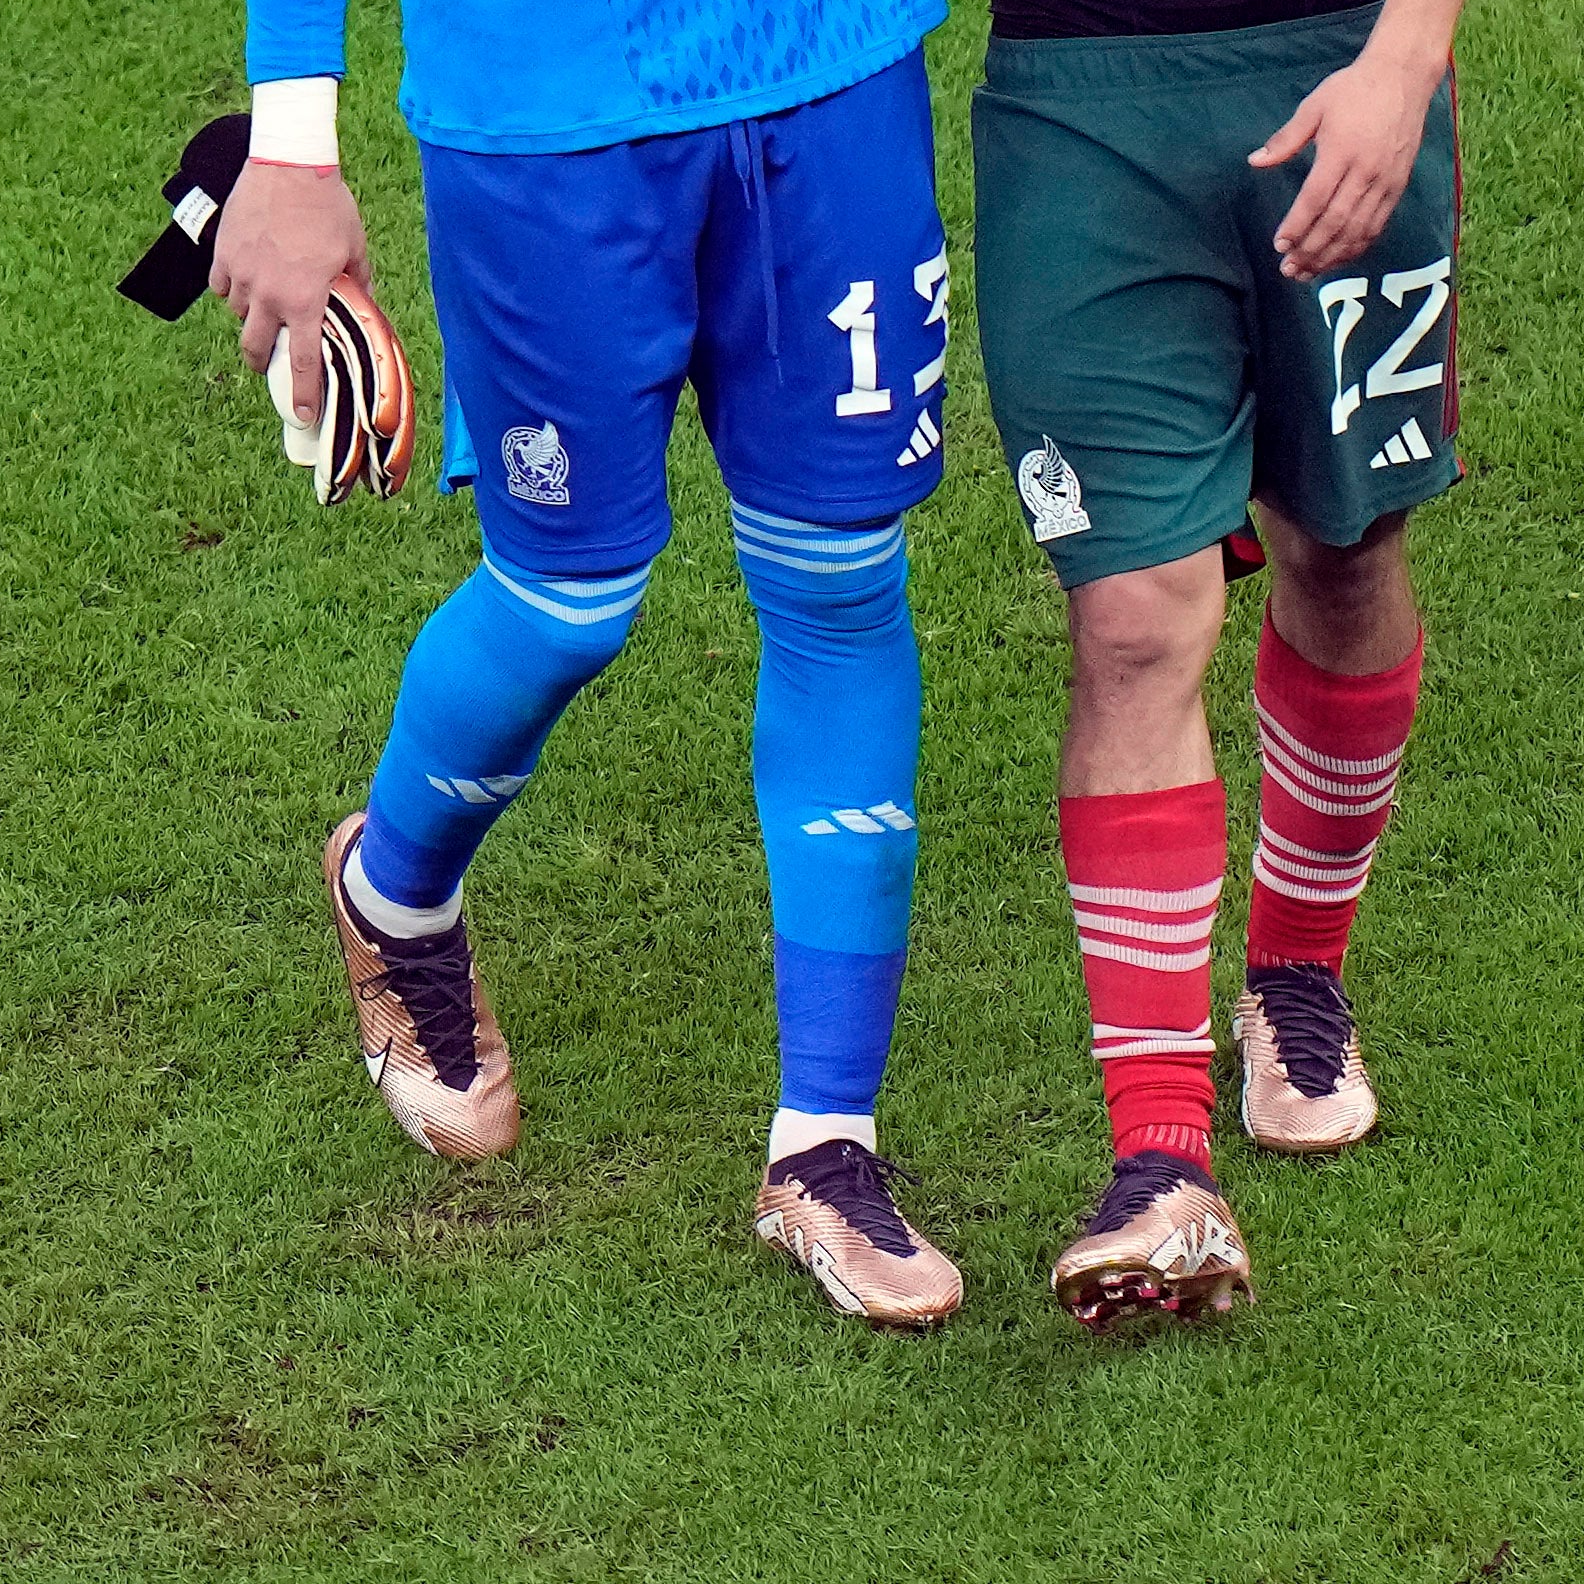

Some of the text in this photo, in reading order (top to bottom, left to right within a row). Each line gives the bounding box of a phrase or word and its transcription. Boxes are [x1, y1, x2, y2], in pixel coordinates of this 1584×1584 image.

[827, 240, 950, 416] 13
[1318, 256, 1451, 435] 22
[1037, 515, 1087, 539] MÉXICO
